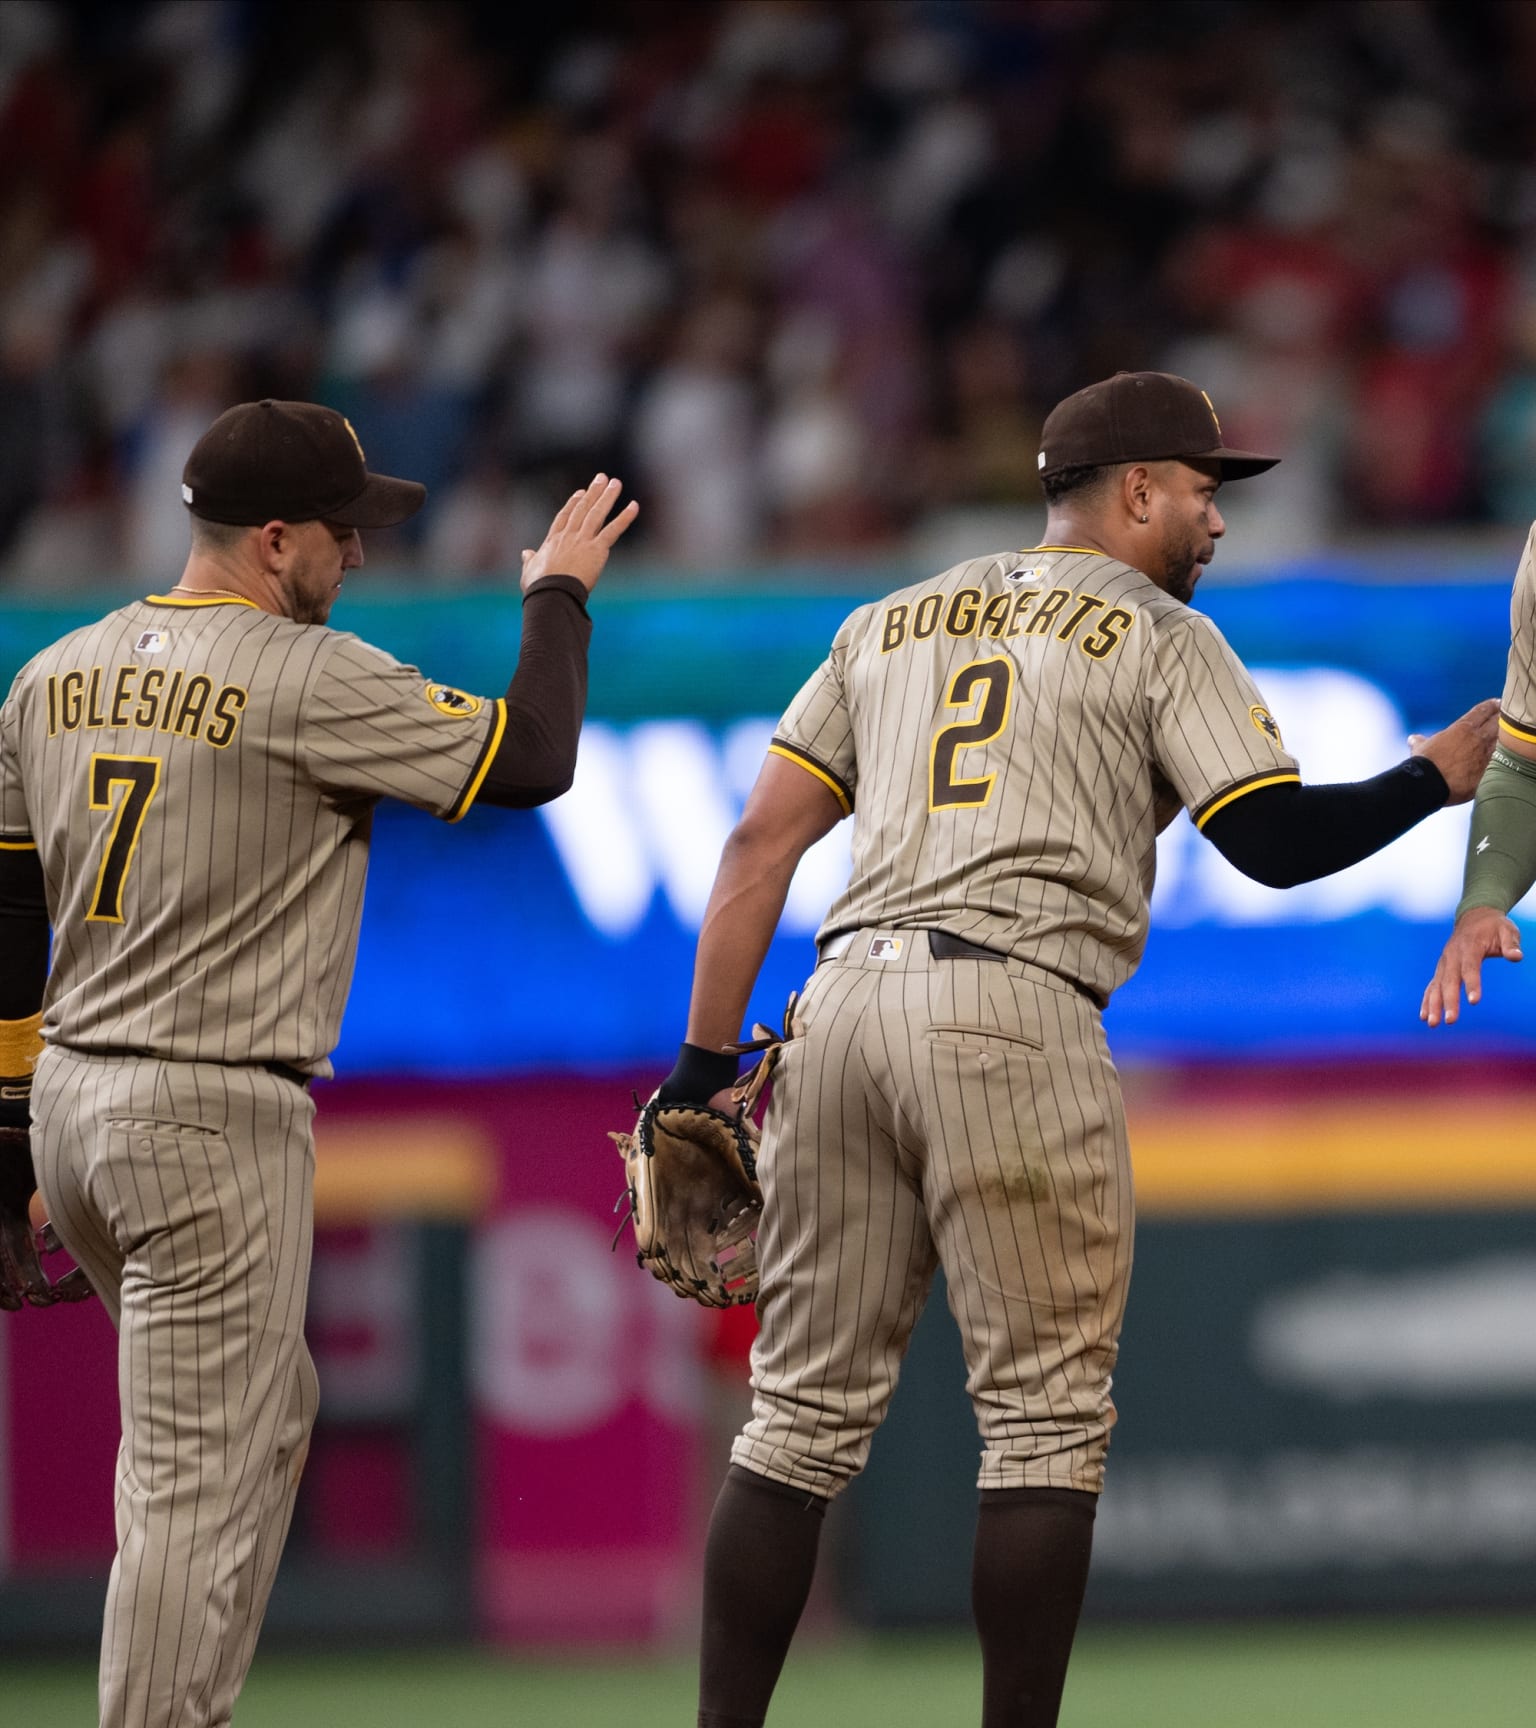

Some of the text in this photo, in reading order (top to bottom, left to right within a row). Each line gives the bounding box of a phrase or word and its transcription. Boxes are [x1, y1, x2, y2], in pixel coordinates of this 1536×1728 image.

[880, 587, 1134, 660] BOGAERTS
[48, 665, 248, 749] IGLESIAS
[927, 654, 1014, 813] 2
[86, 753, 162, 924] 7
